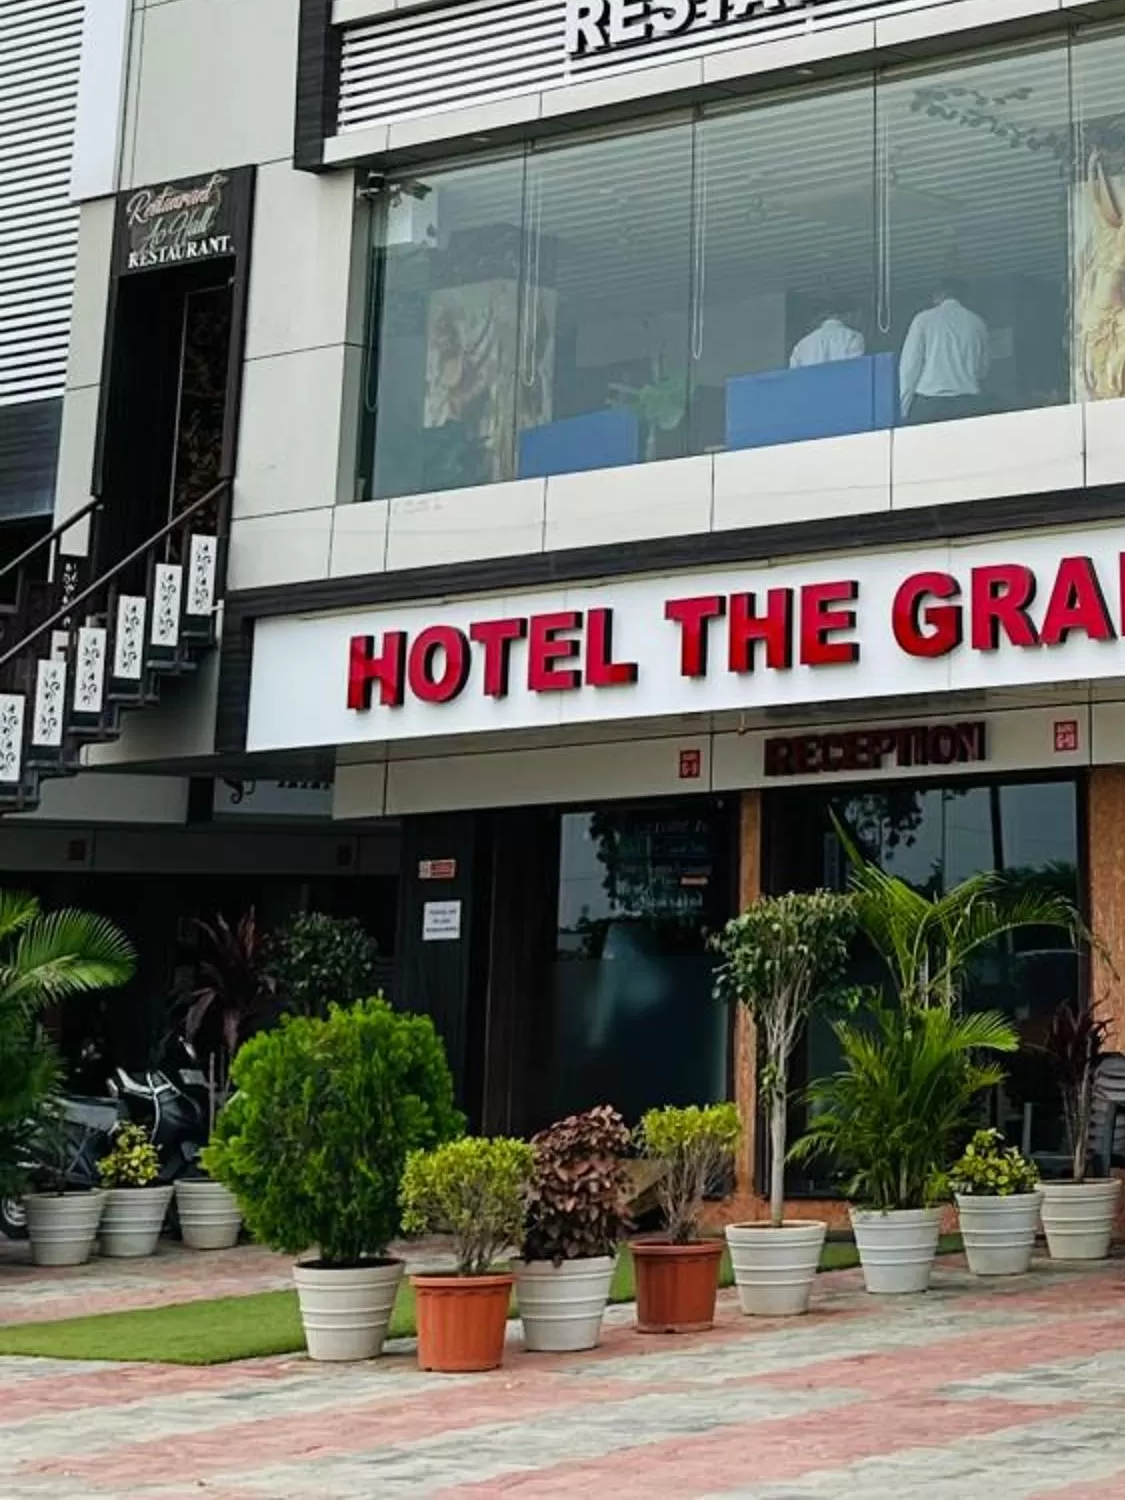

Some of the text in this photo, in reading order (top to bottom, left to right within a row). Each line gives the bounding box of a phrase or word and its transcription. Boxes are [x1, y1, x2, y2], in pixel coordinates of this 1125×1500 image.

[346, 607, 638, 712] HOTEL
[664, 580, 859, 677] THE
[764, 721, 986, 777] RECEPTION
